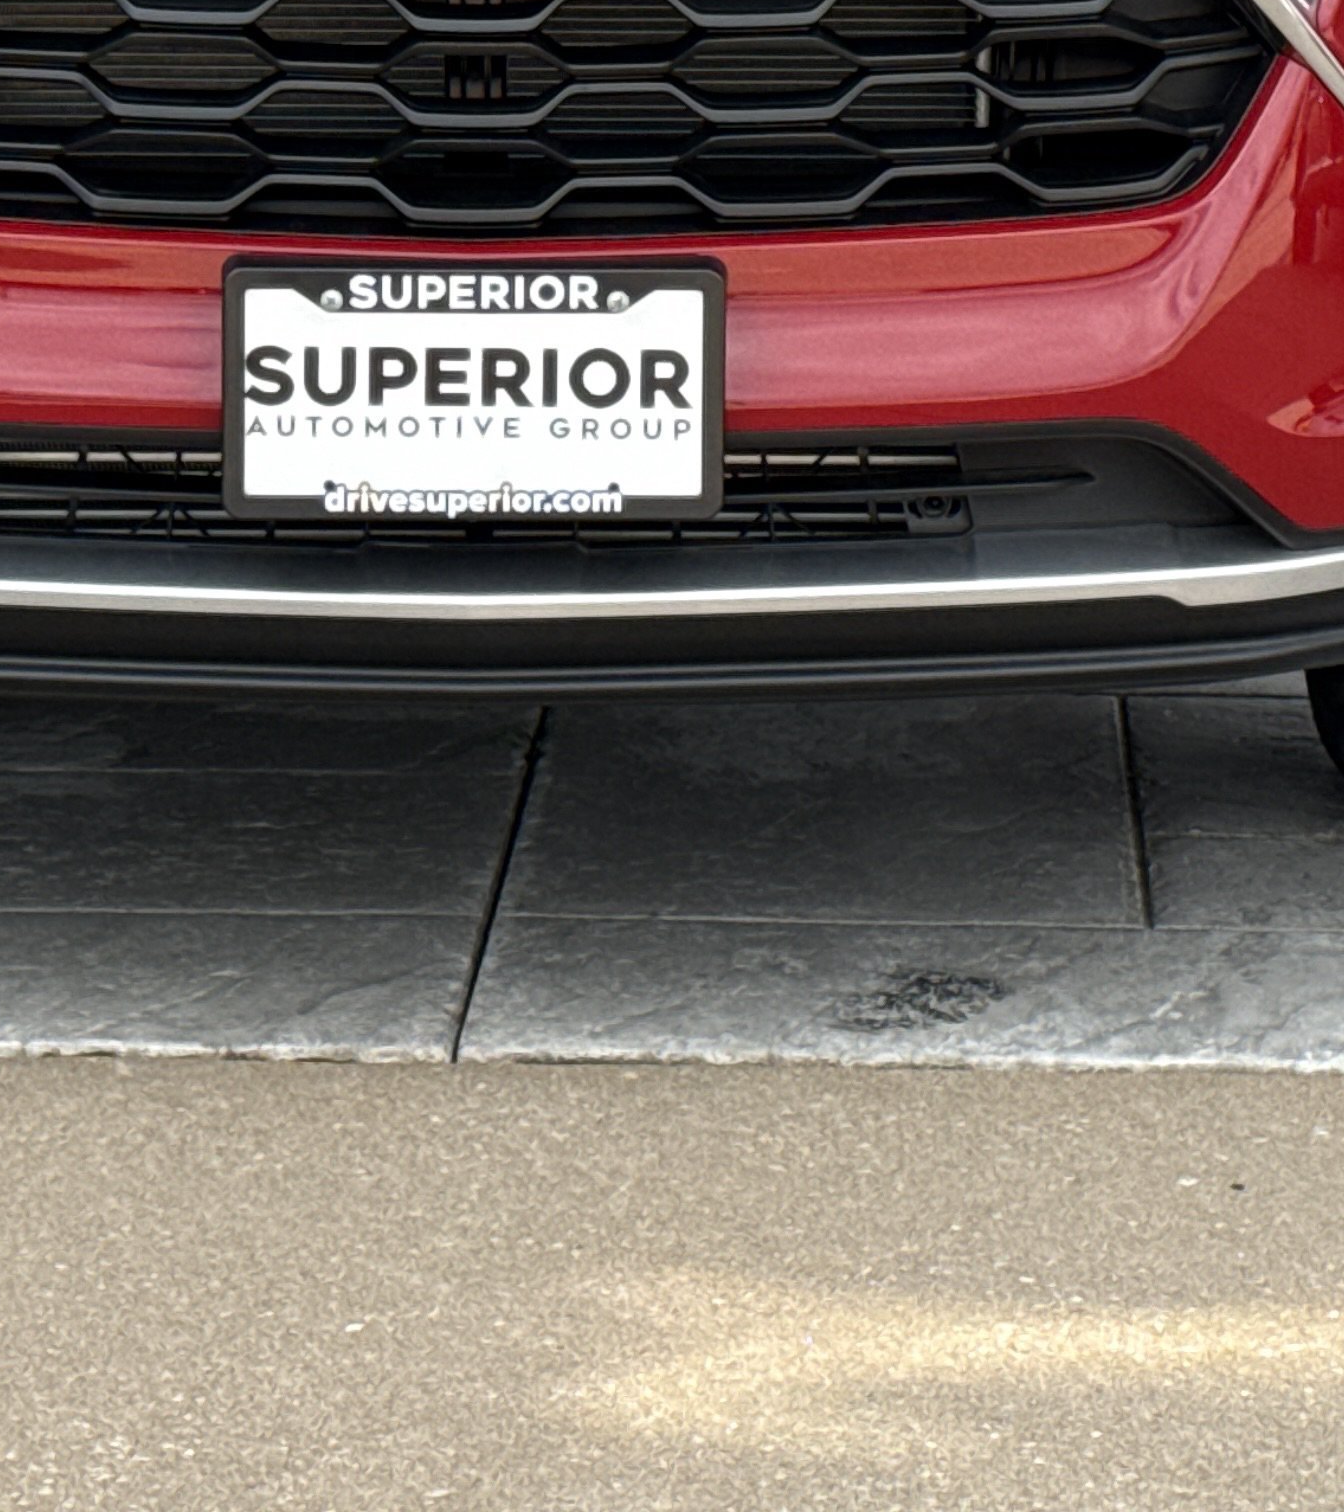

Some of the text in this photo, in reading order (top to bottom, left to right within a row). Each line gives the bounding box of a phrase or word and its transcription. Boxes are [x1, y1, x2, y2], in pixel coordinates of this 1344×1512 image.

[348, 274, 599, 311] SUPERIOR
[244, 345, 694, 410] SUPERIOR
[246, 415, 692, 441] AUTOMOTIVE GROUP
[324, 482, 622, 518] drivesuperior.com
